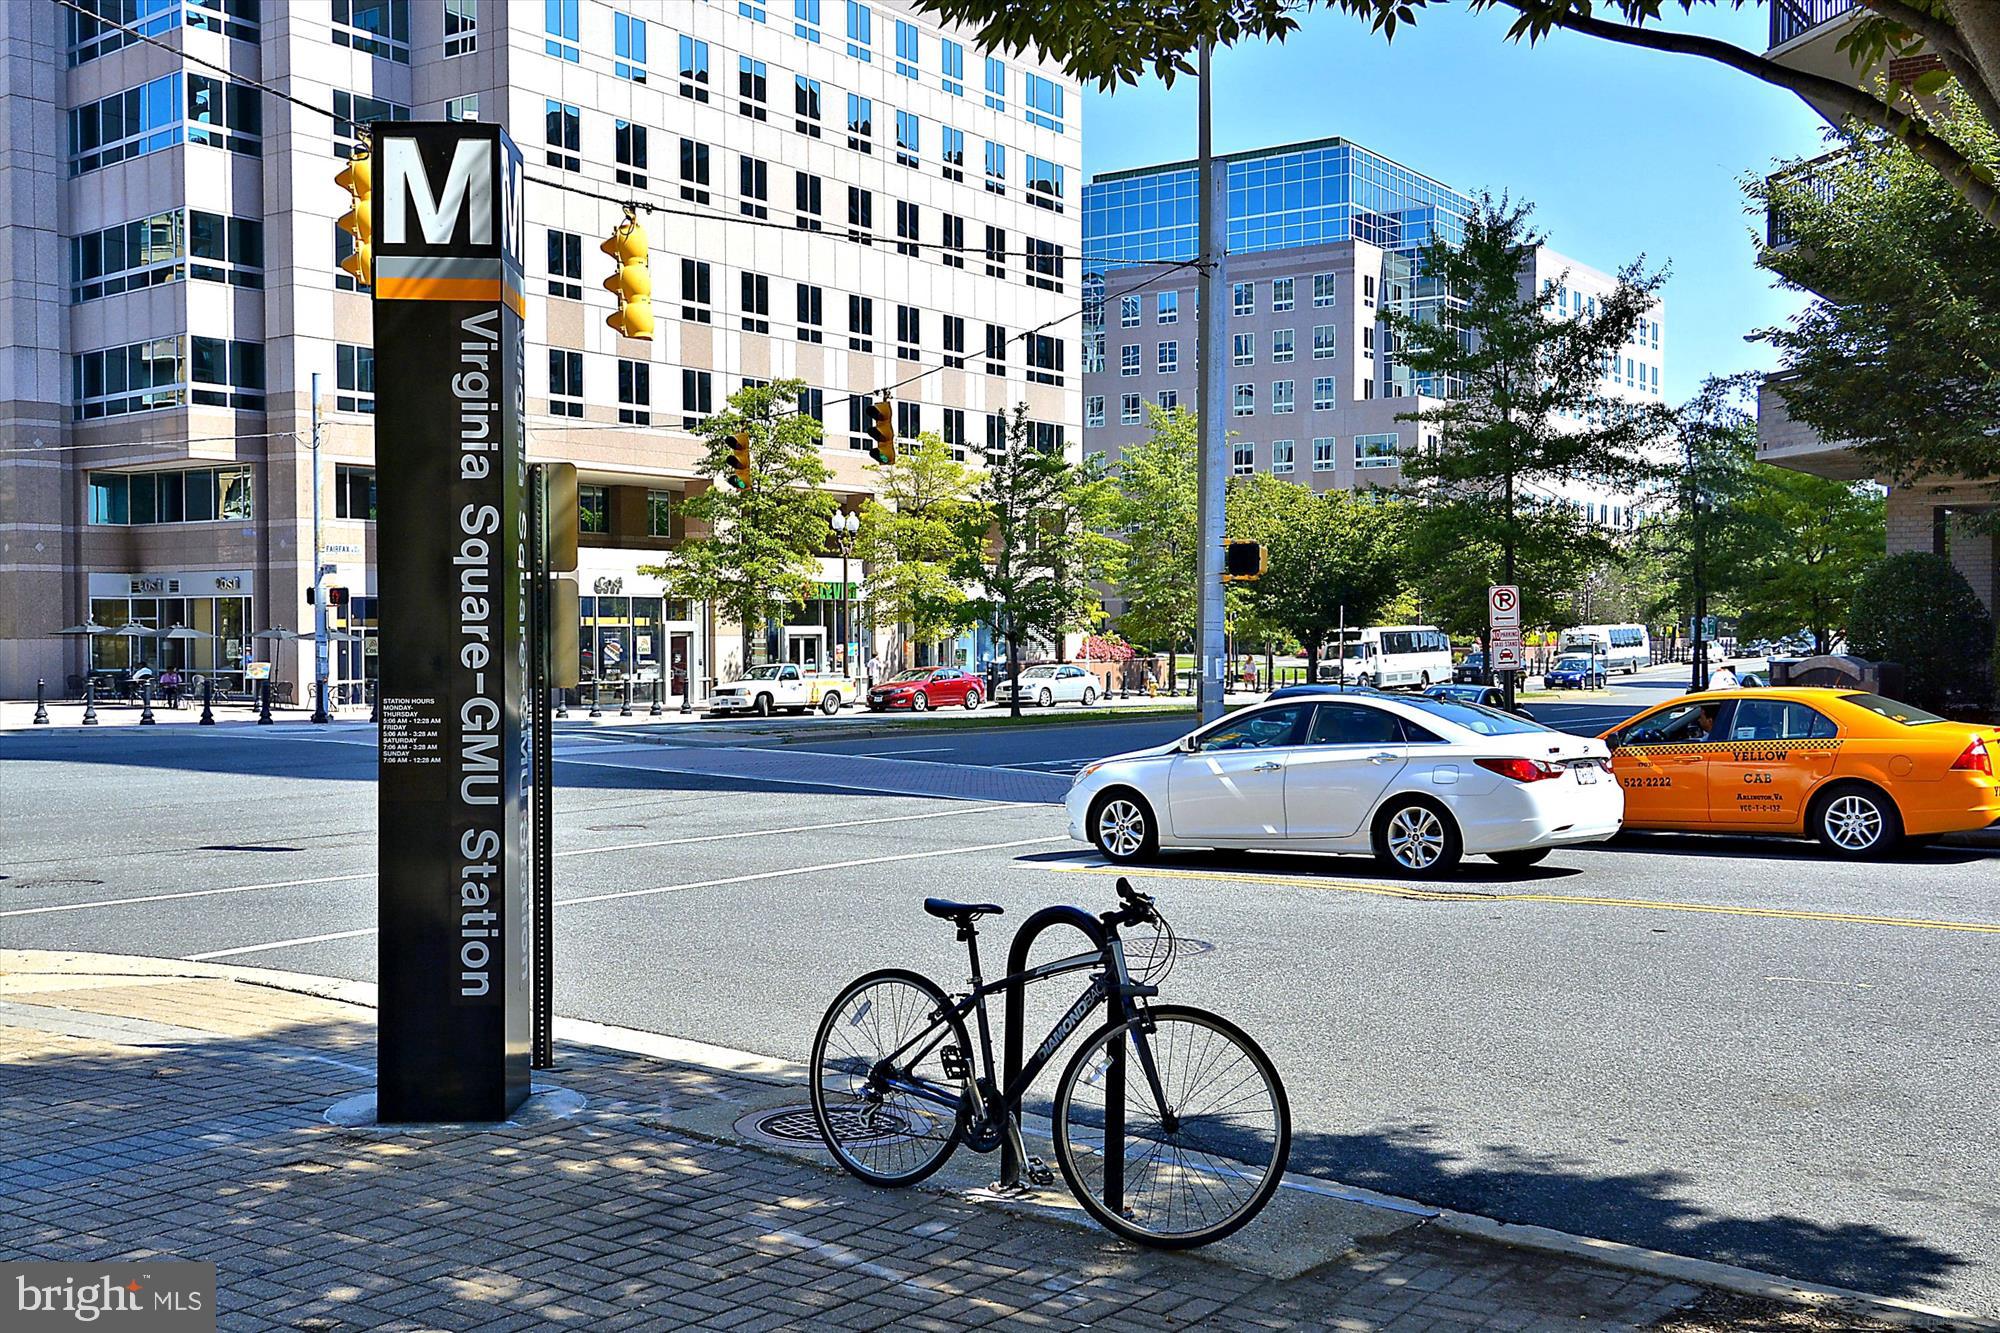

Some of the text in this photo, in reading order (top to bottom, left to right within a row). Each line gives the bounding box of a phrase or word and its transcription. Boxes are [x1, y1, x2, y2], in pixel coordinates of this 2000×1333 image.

[383, 137, 492, 244] M
[501, 140, 523, 266] M
[326, 545, 350, 553] FAIRFAX
[452, 309, 500, 996] Virginia Square-GMU Station
[1733, 751, 1788, 762] YELLOW
[1743, 774, 1772, 784] CAB
